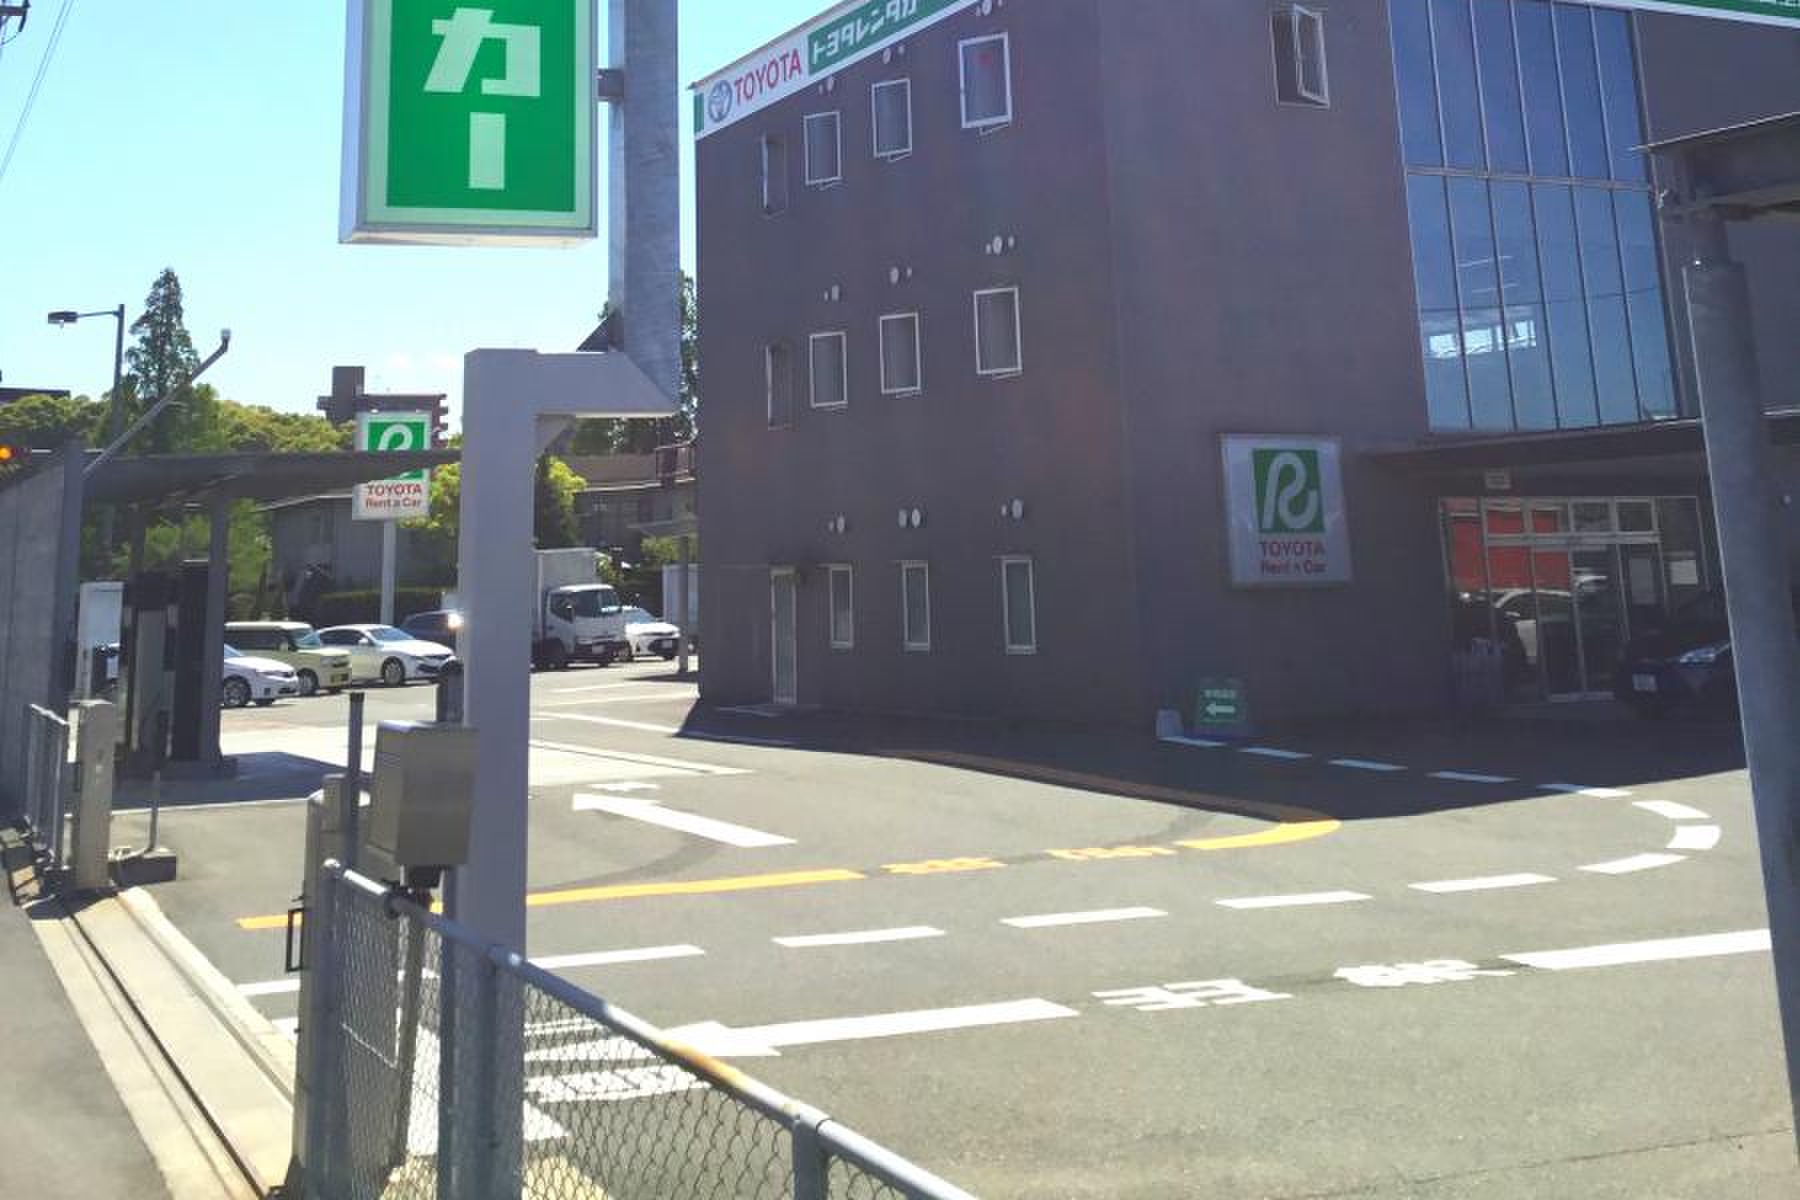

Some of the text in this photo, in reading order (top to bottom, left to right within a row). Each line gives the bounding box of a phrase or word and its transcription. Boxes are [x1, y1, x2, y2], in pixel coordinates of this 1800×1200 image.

[734, 47, 802, 104] TOYOTA
[368, 484, 422, 496] TOYOTA
[1259, 540, 1325, 557] TOYOTA
